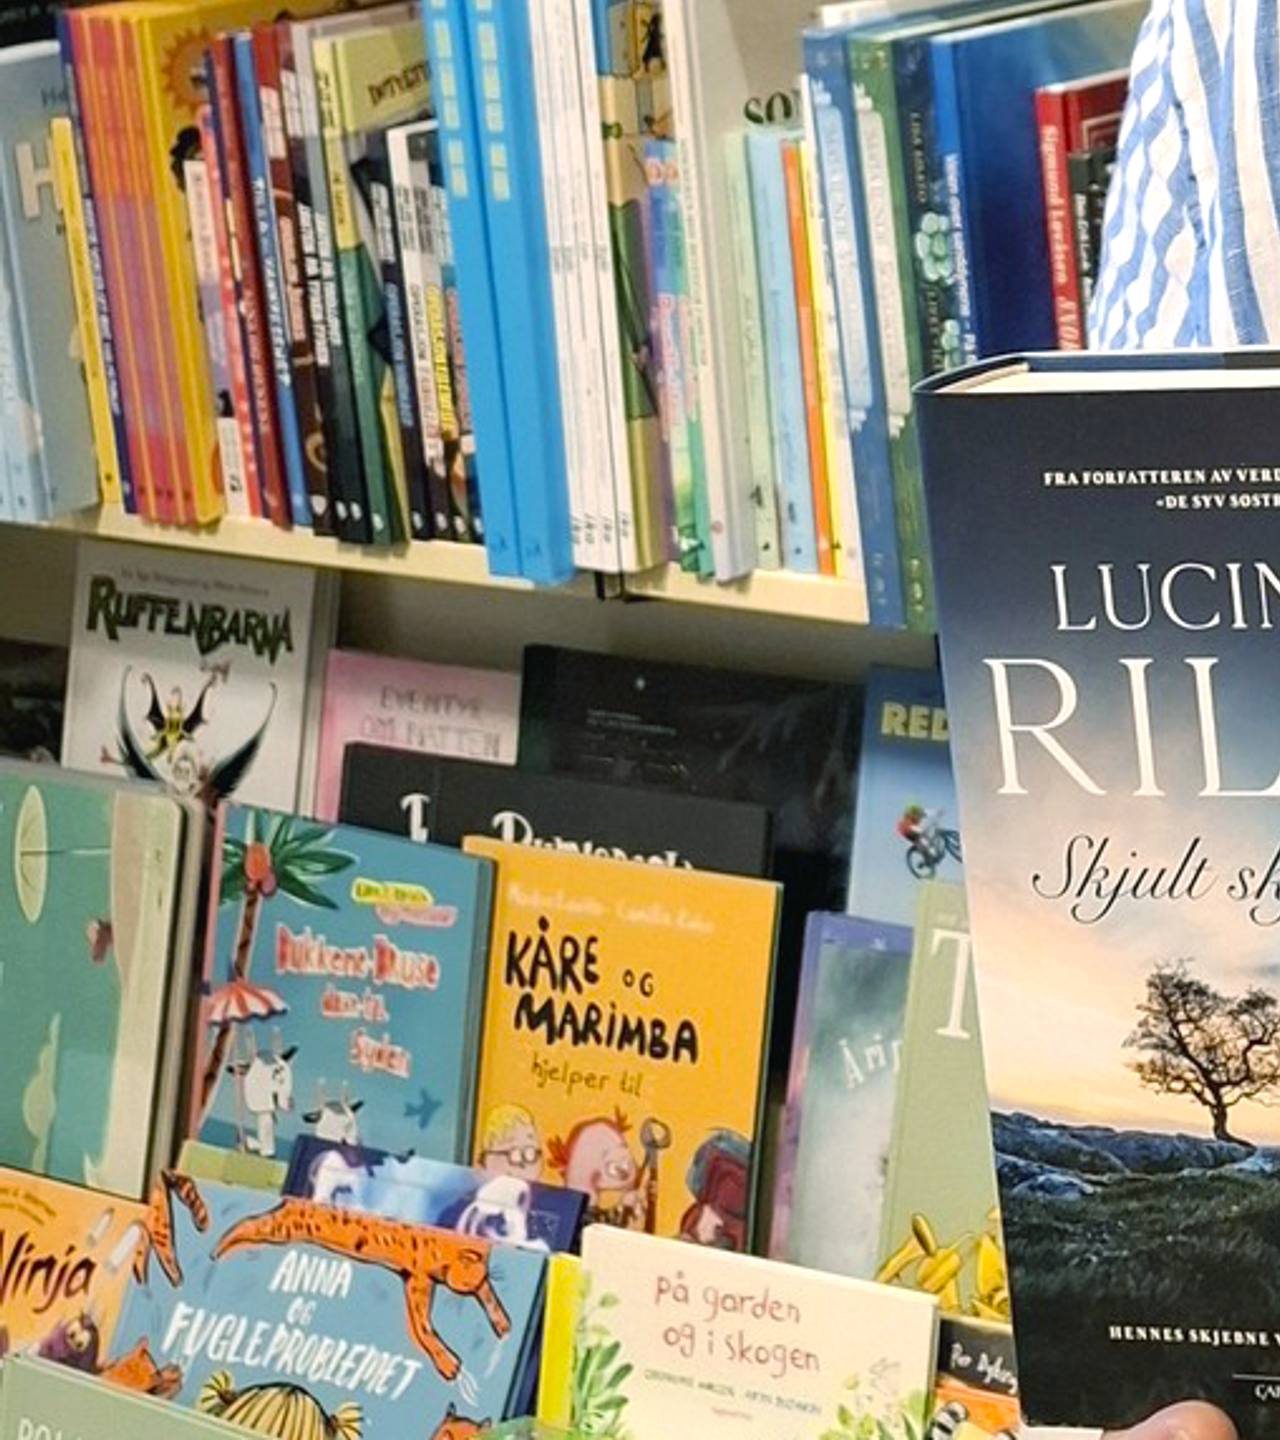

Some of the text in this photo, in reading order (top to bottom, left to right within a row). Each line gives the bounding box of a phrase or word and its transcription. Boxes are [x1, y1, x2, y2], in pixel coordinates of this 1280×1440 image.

[1042, 125, 1062, 203] Sigmund
[1043, 470, 1080, 486] FRA
[1082, 468, 1206, 486] FORFATTEREN
[1210, 468, 1234, 484] AV
[1191, 492, 1228, 510] SYV
[86, 574, 294, 665] RUFFENBARNA
[1032, 833, 1218, 925] Skjult
[506, 915, 600, 994] KÅRE
[530, 1053, 644, 1098] hjelper til
[267, 1249, 353, 1298] ANNA
[286, 1299, 318, 1326] OG
[702, 1285, 802, 1325] garden
[160, 1300, 425, 1400] FUGLEPROBLEMET
[662, 1322, 697, 1359] og
[723, 1331, 821, 1380] skogen
[1108, 1324, 1185, 1344] HENNES
[1188, 1328, 1270, 1349] SKJEBNE
